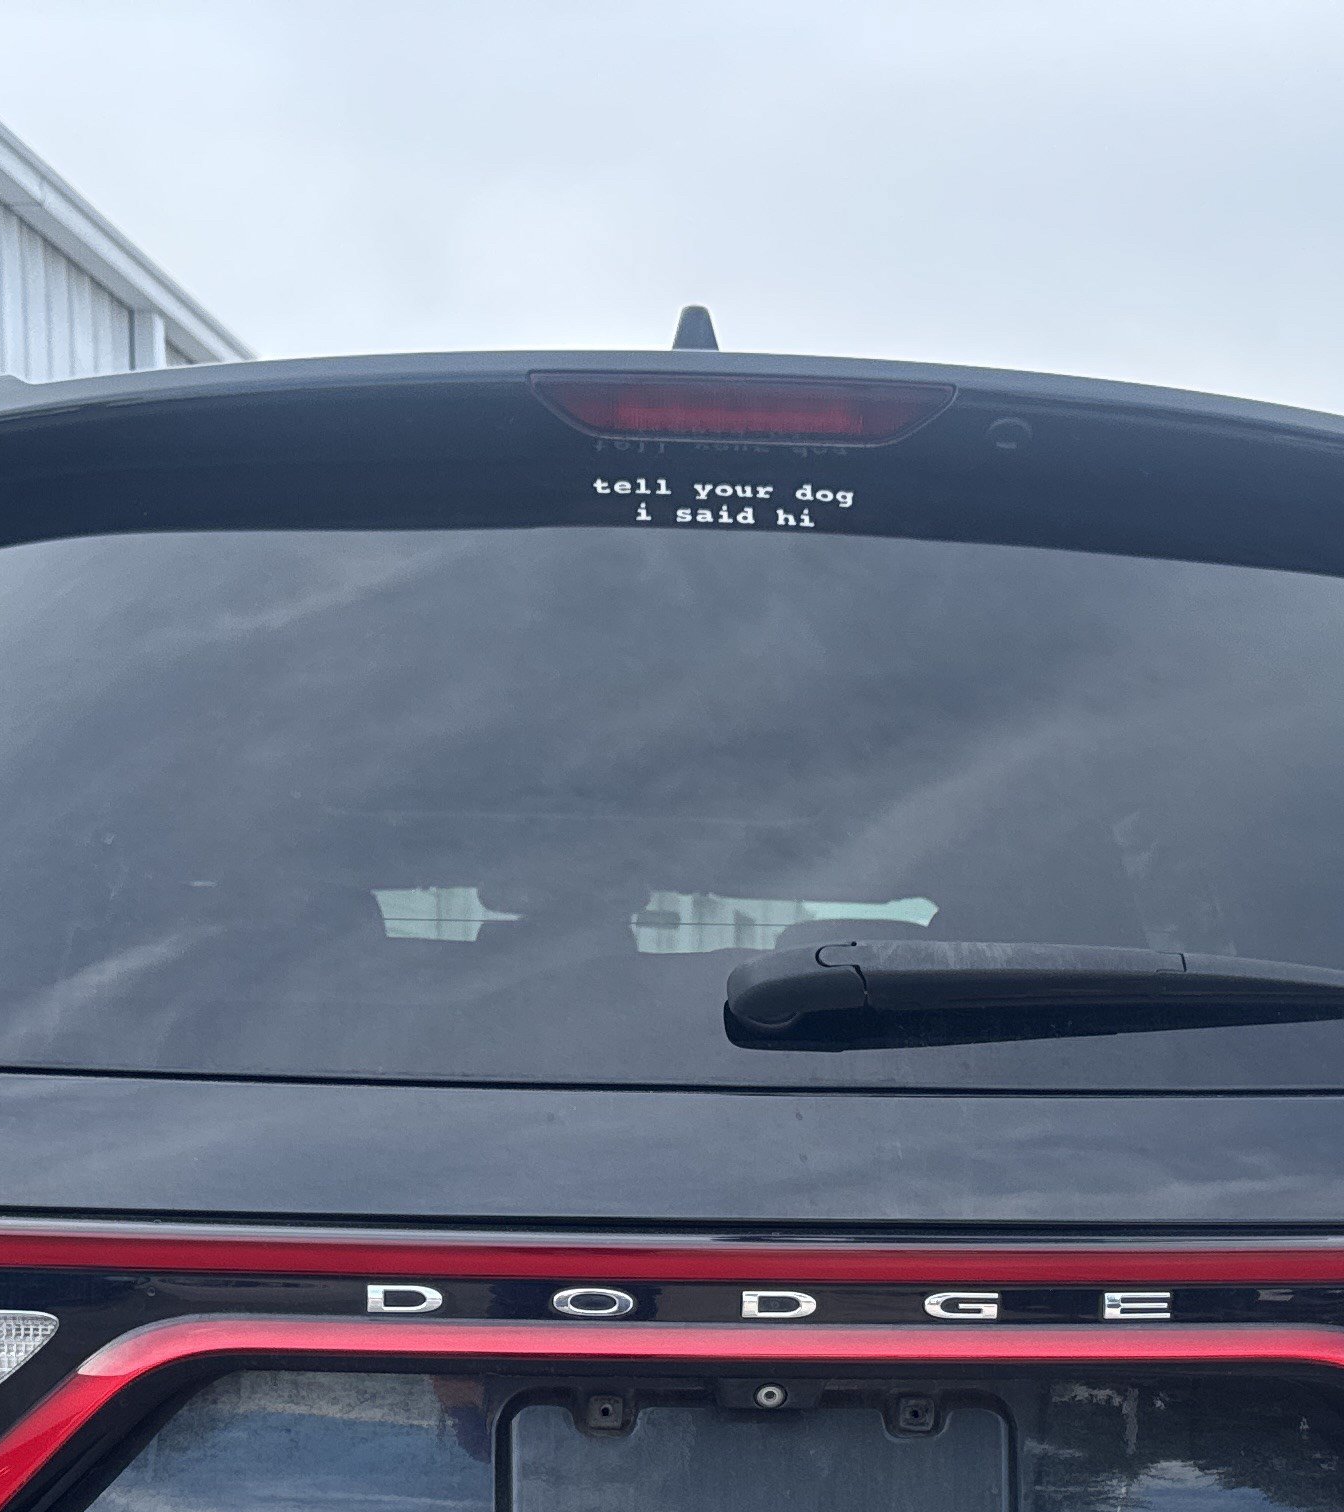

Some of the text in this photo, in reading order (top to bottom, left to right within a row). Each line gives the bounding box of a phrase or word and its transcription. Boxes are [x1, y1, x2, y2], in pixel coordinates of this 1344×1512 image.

[593, 478, 855, 508] tell your dog
[635, 502, 815, 527] i said hi
[365, 1283, 1173, 1320] DODGE
